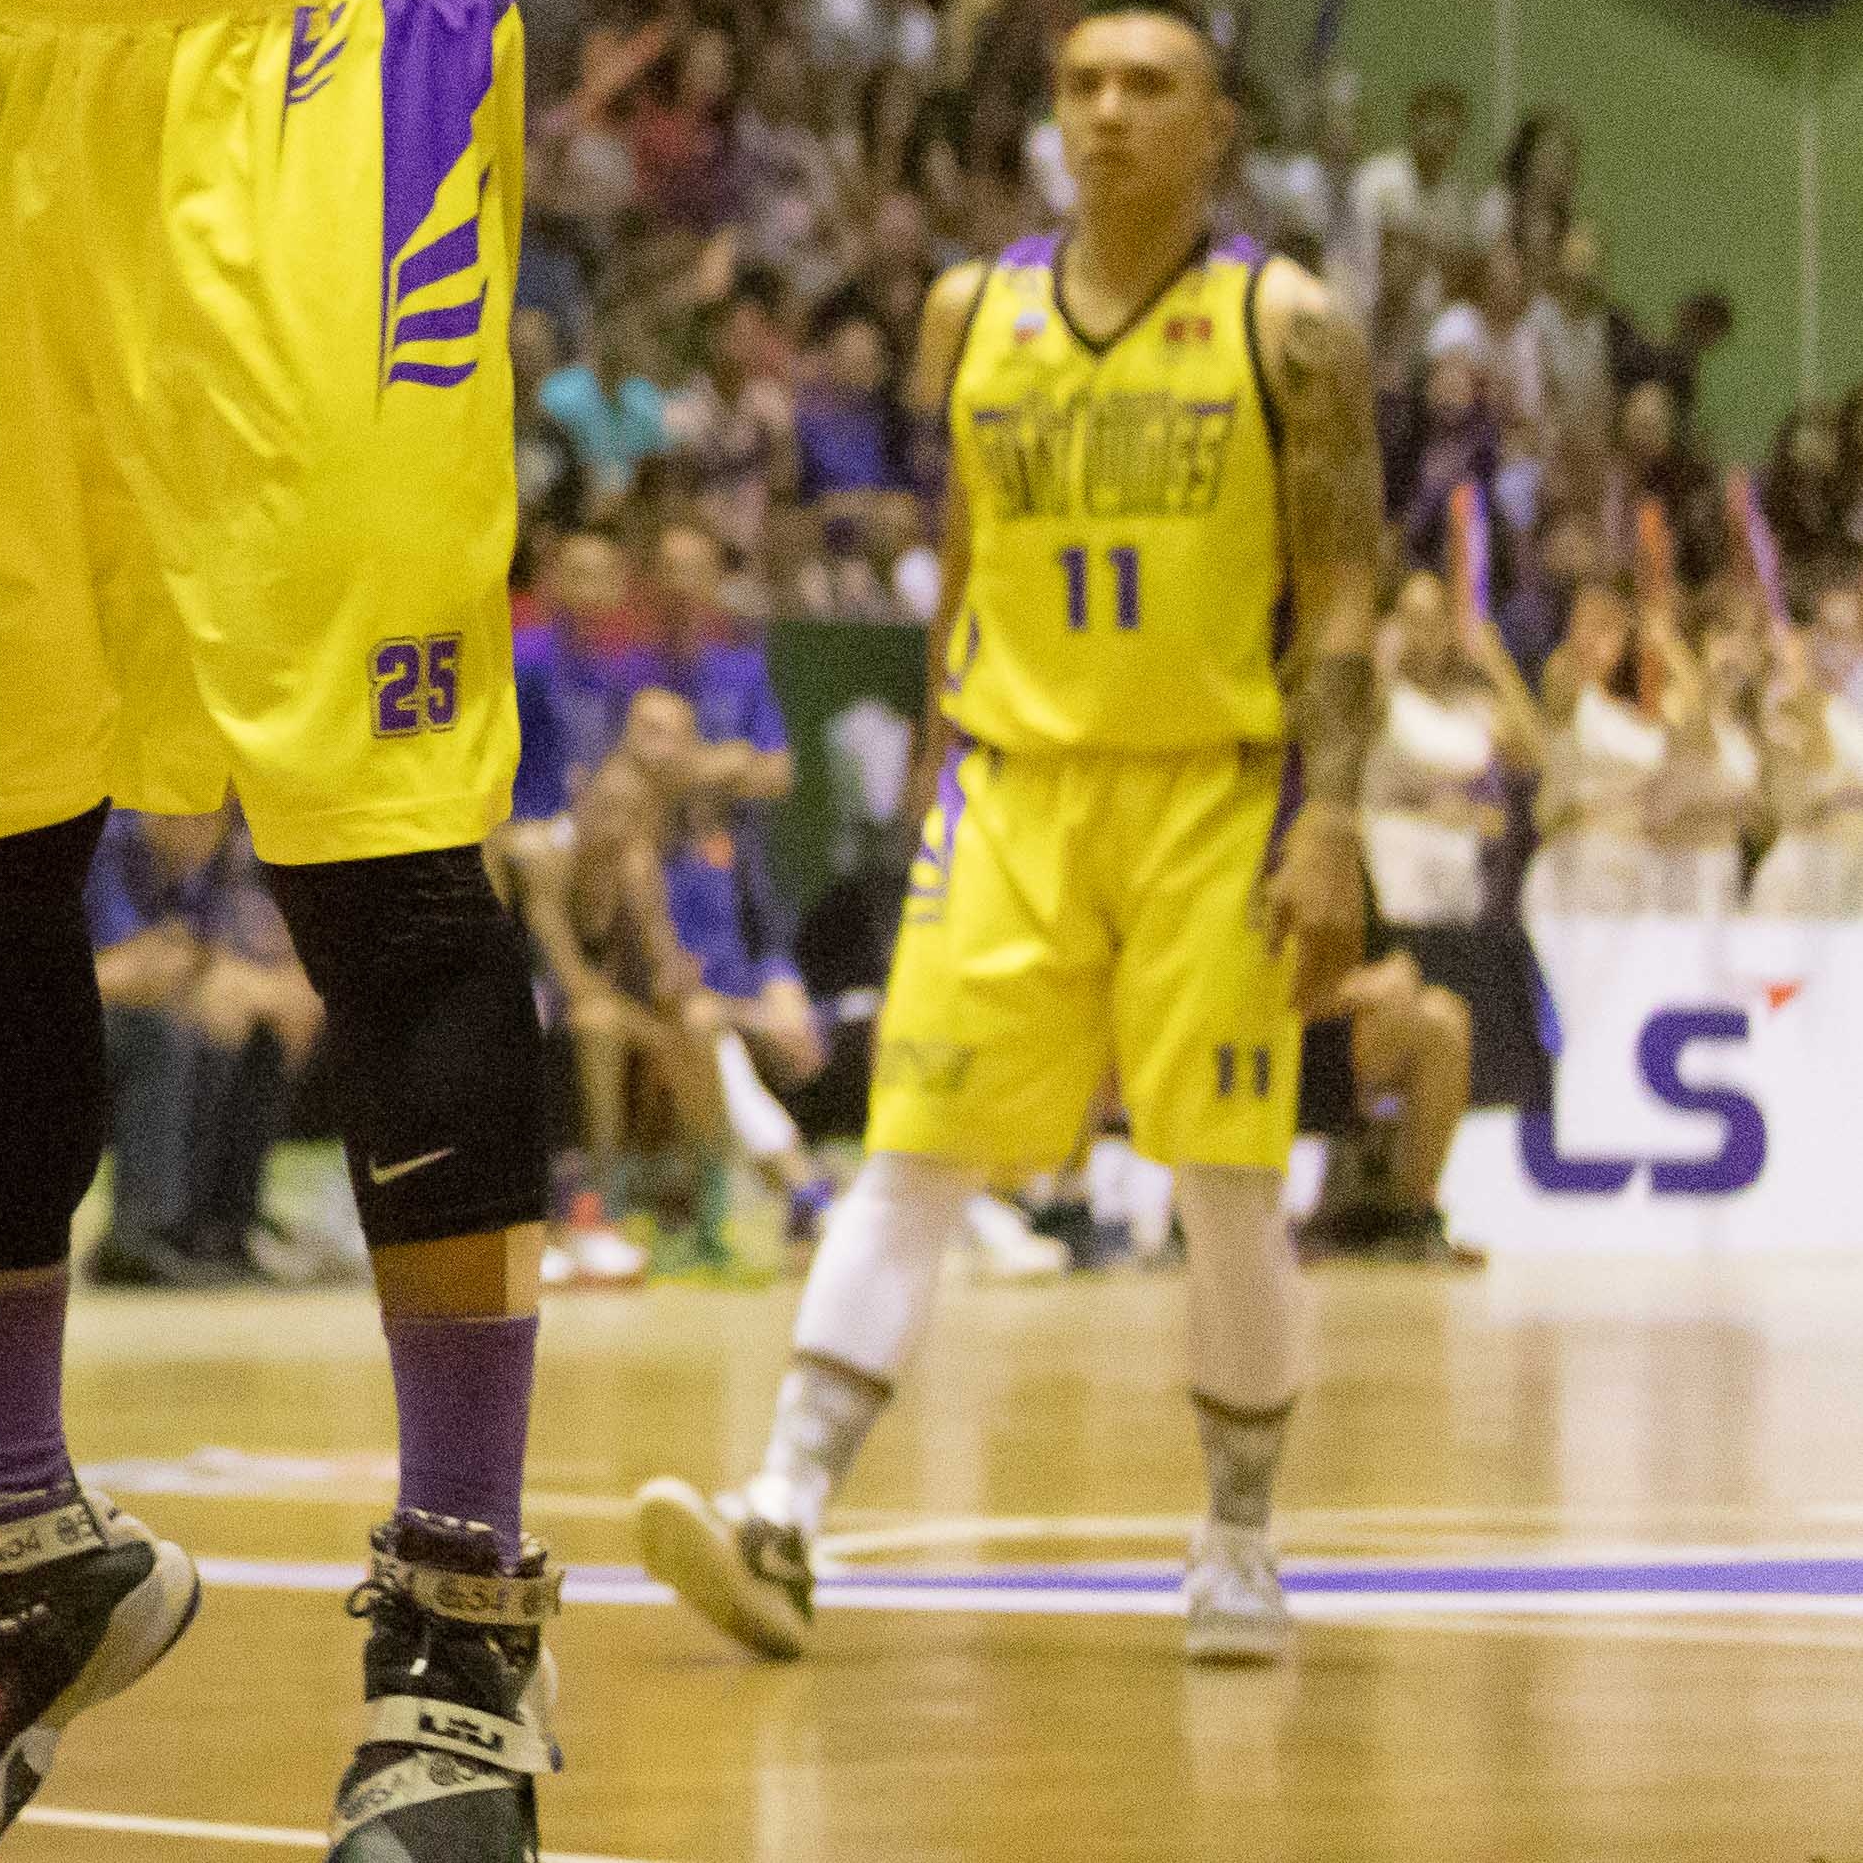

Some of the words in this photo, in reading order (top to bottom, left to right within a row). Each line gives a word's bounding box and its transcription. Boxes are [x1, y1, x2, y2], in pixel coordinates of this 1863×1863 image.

[1057, 544, 1141, 633] 11
[369, 633, 465, 739] 25
[1214, 1040, 1274, 1102] 11
[1518, 1003, 1770, 1199] LS
